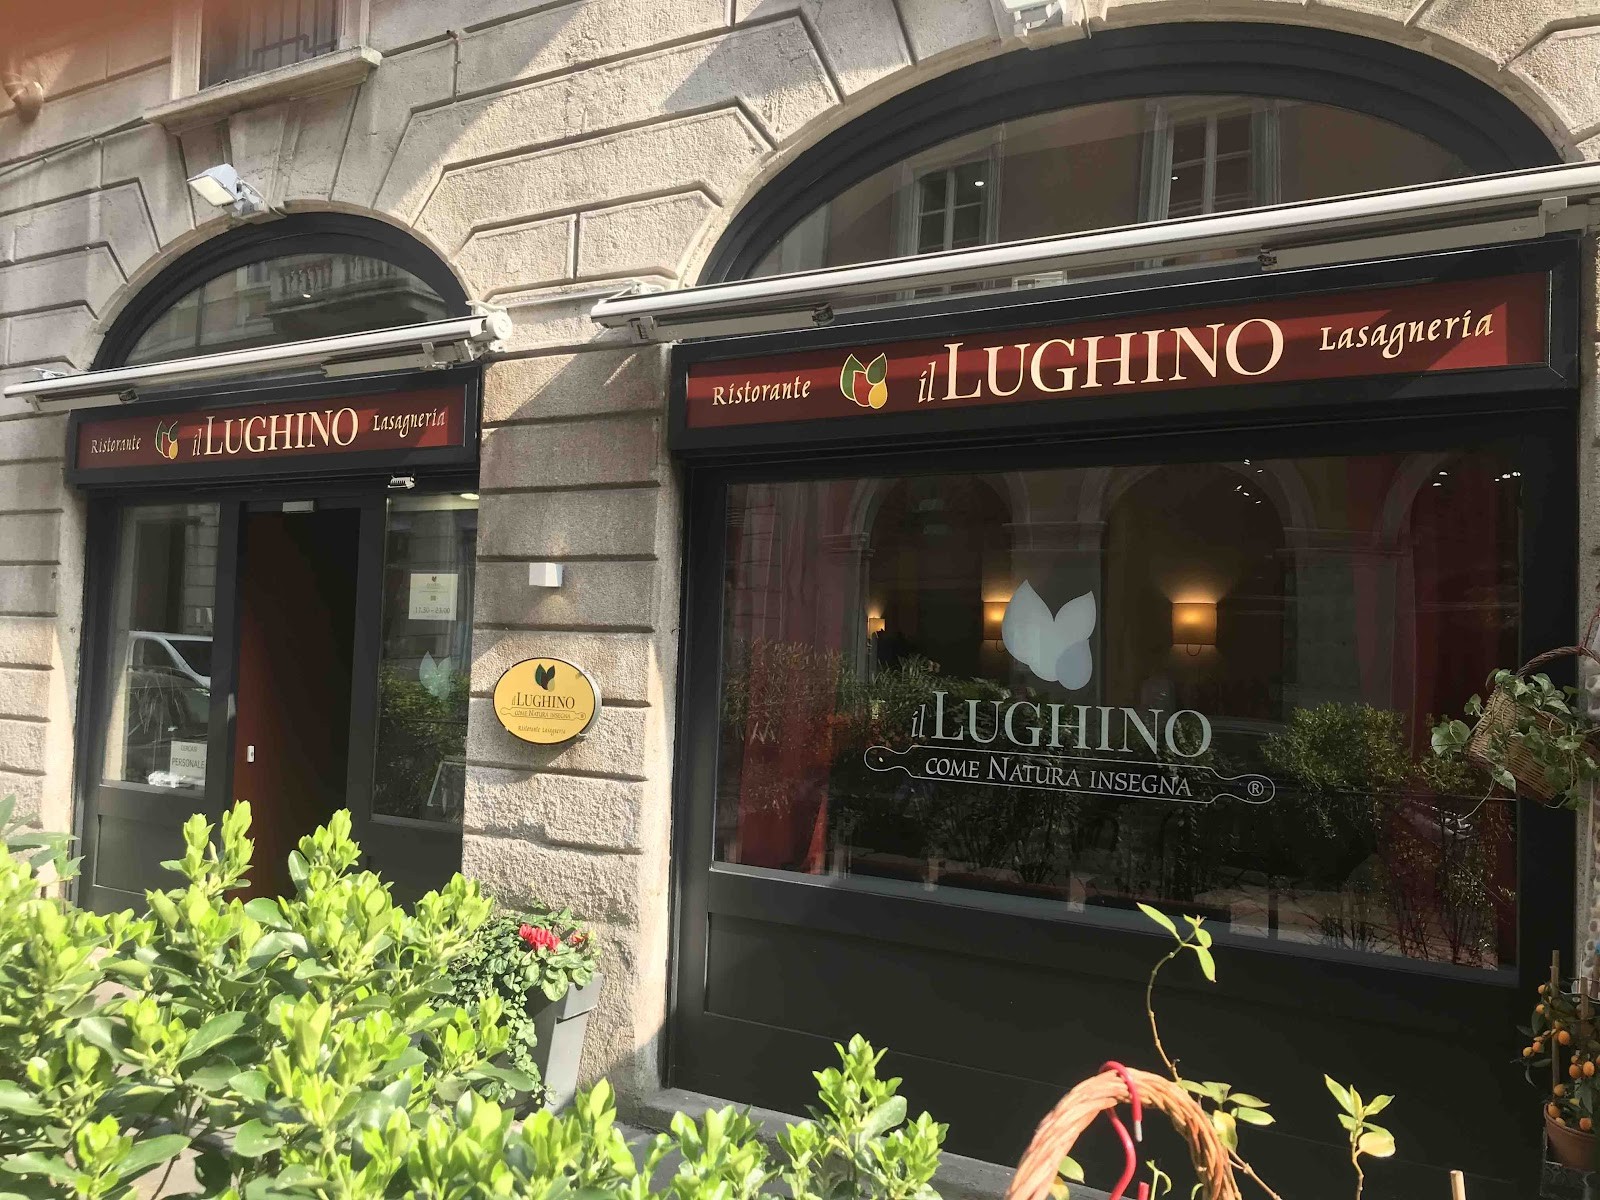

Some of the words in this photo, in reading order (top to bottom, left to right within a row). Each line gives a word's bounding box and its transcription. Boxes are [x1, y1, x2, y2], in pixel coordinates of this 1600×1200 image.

[712, 374, 811, 406] Ristorante
[918, 360, 937, 403] il
[942, 318, 1284, 401] LUGHINO
[1319, 309, 1494, 359] Lasagneria
[91, 434, 142, 454] Ristorante
[192, 428, 202, 456] il
[204, 407, 359, 456] LUGHINO
[373, 407, 446, 438] Lasagneria
[517, 692, 575, 710] LUGHINO
[911, 703, 925, 738] il
[931, 690, 1213, 758] LUGHINO
[171, 757, 205, 769] PERSONALE
